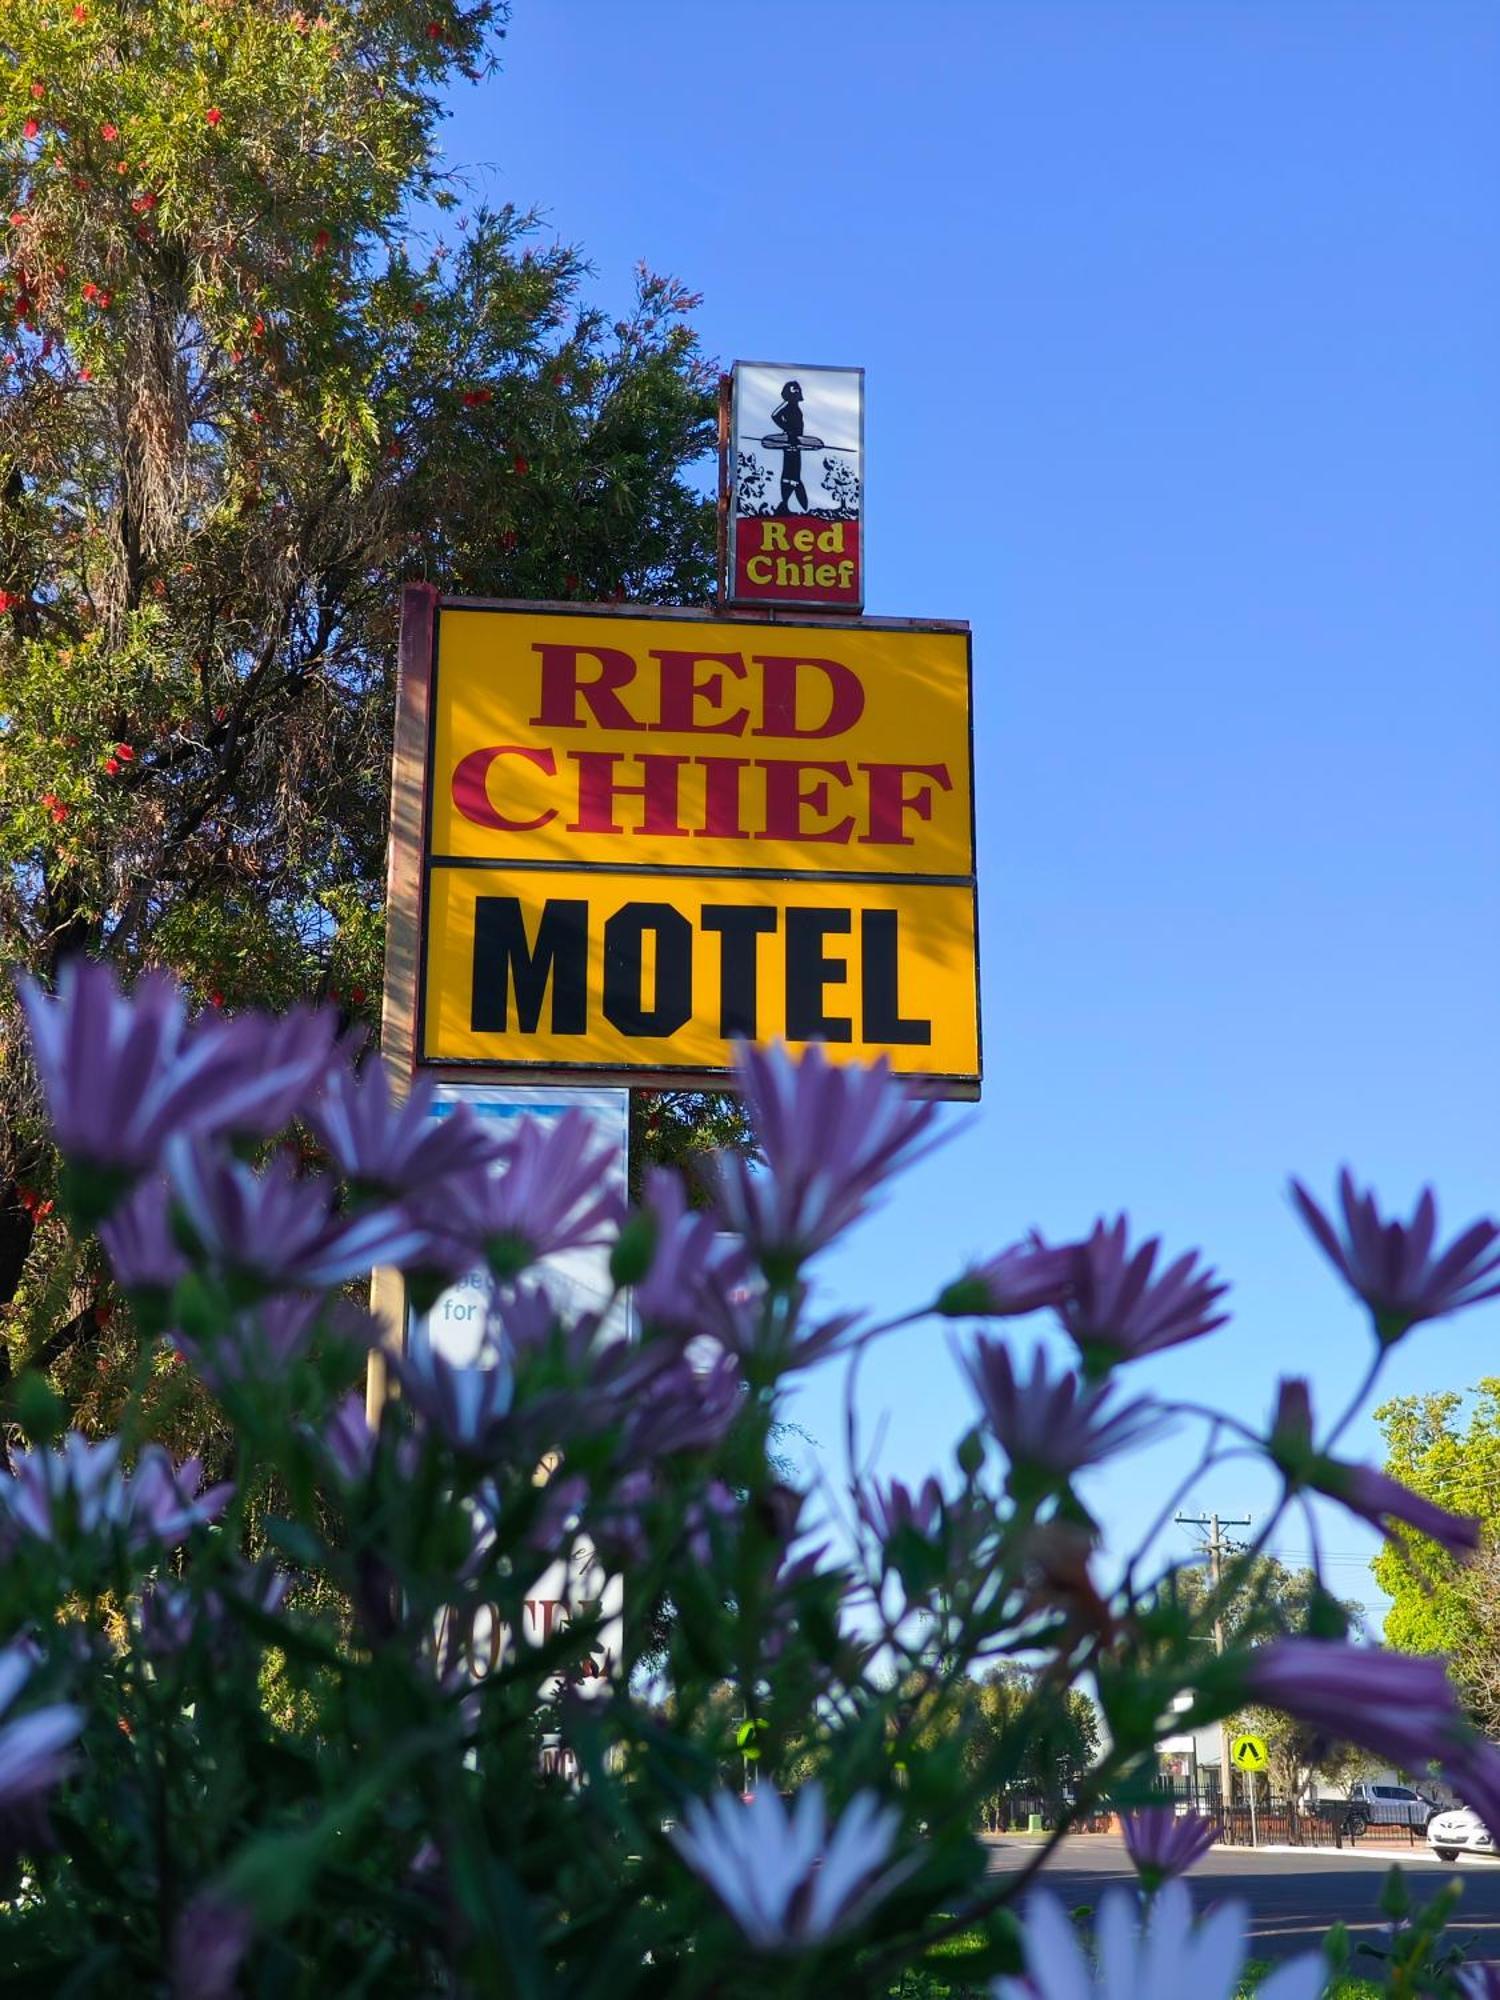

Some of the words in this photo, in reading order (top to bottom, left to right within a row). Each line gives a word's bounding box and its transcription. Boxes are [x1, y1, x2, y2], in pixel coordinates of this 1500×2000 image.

[761, 521, 846, 553] Red
[747, 554, 854, 588] Chief
[529, 643, 865, 739] RED
[452, 745, 953, 845] CHIEF
[471, 896, 931, 1045] MOTEL
[444, 1299, 477, 1320] for
